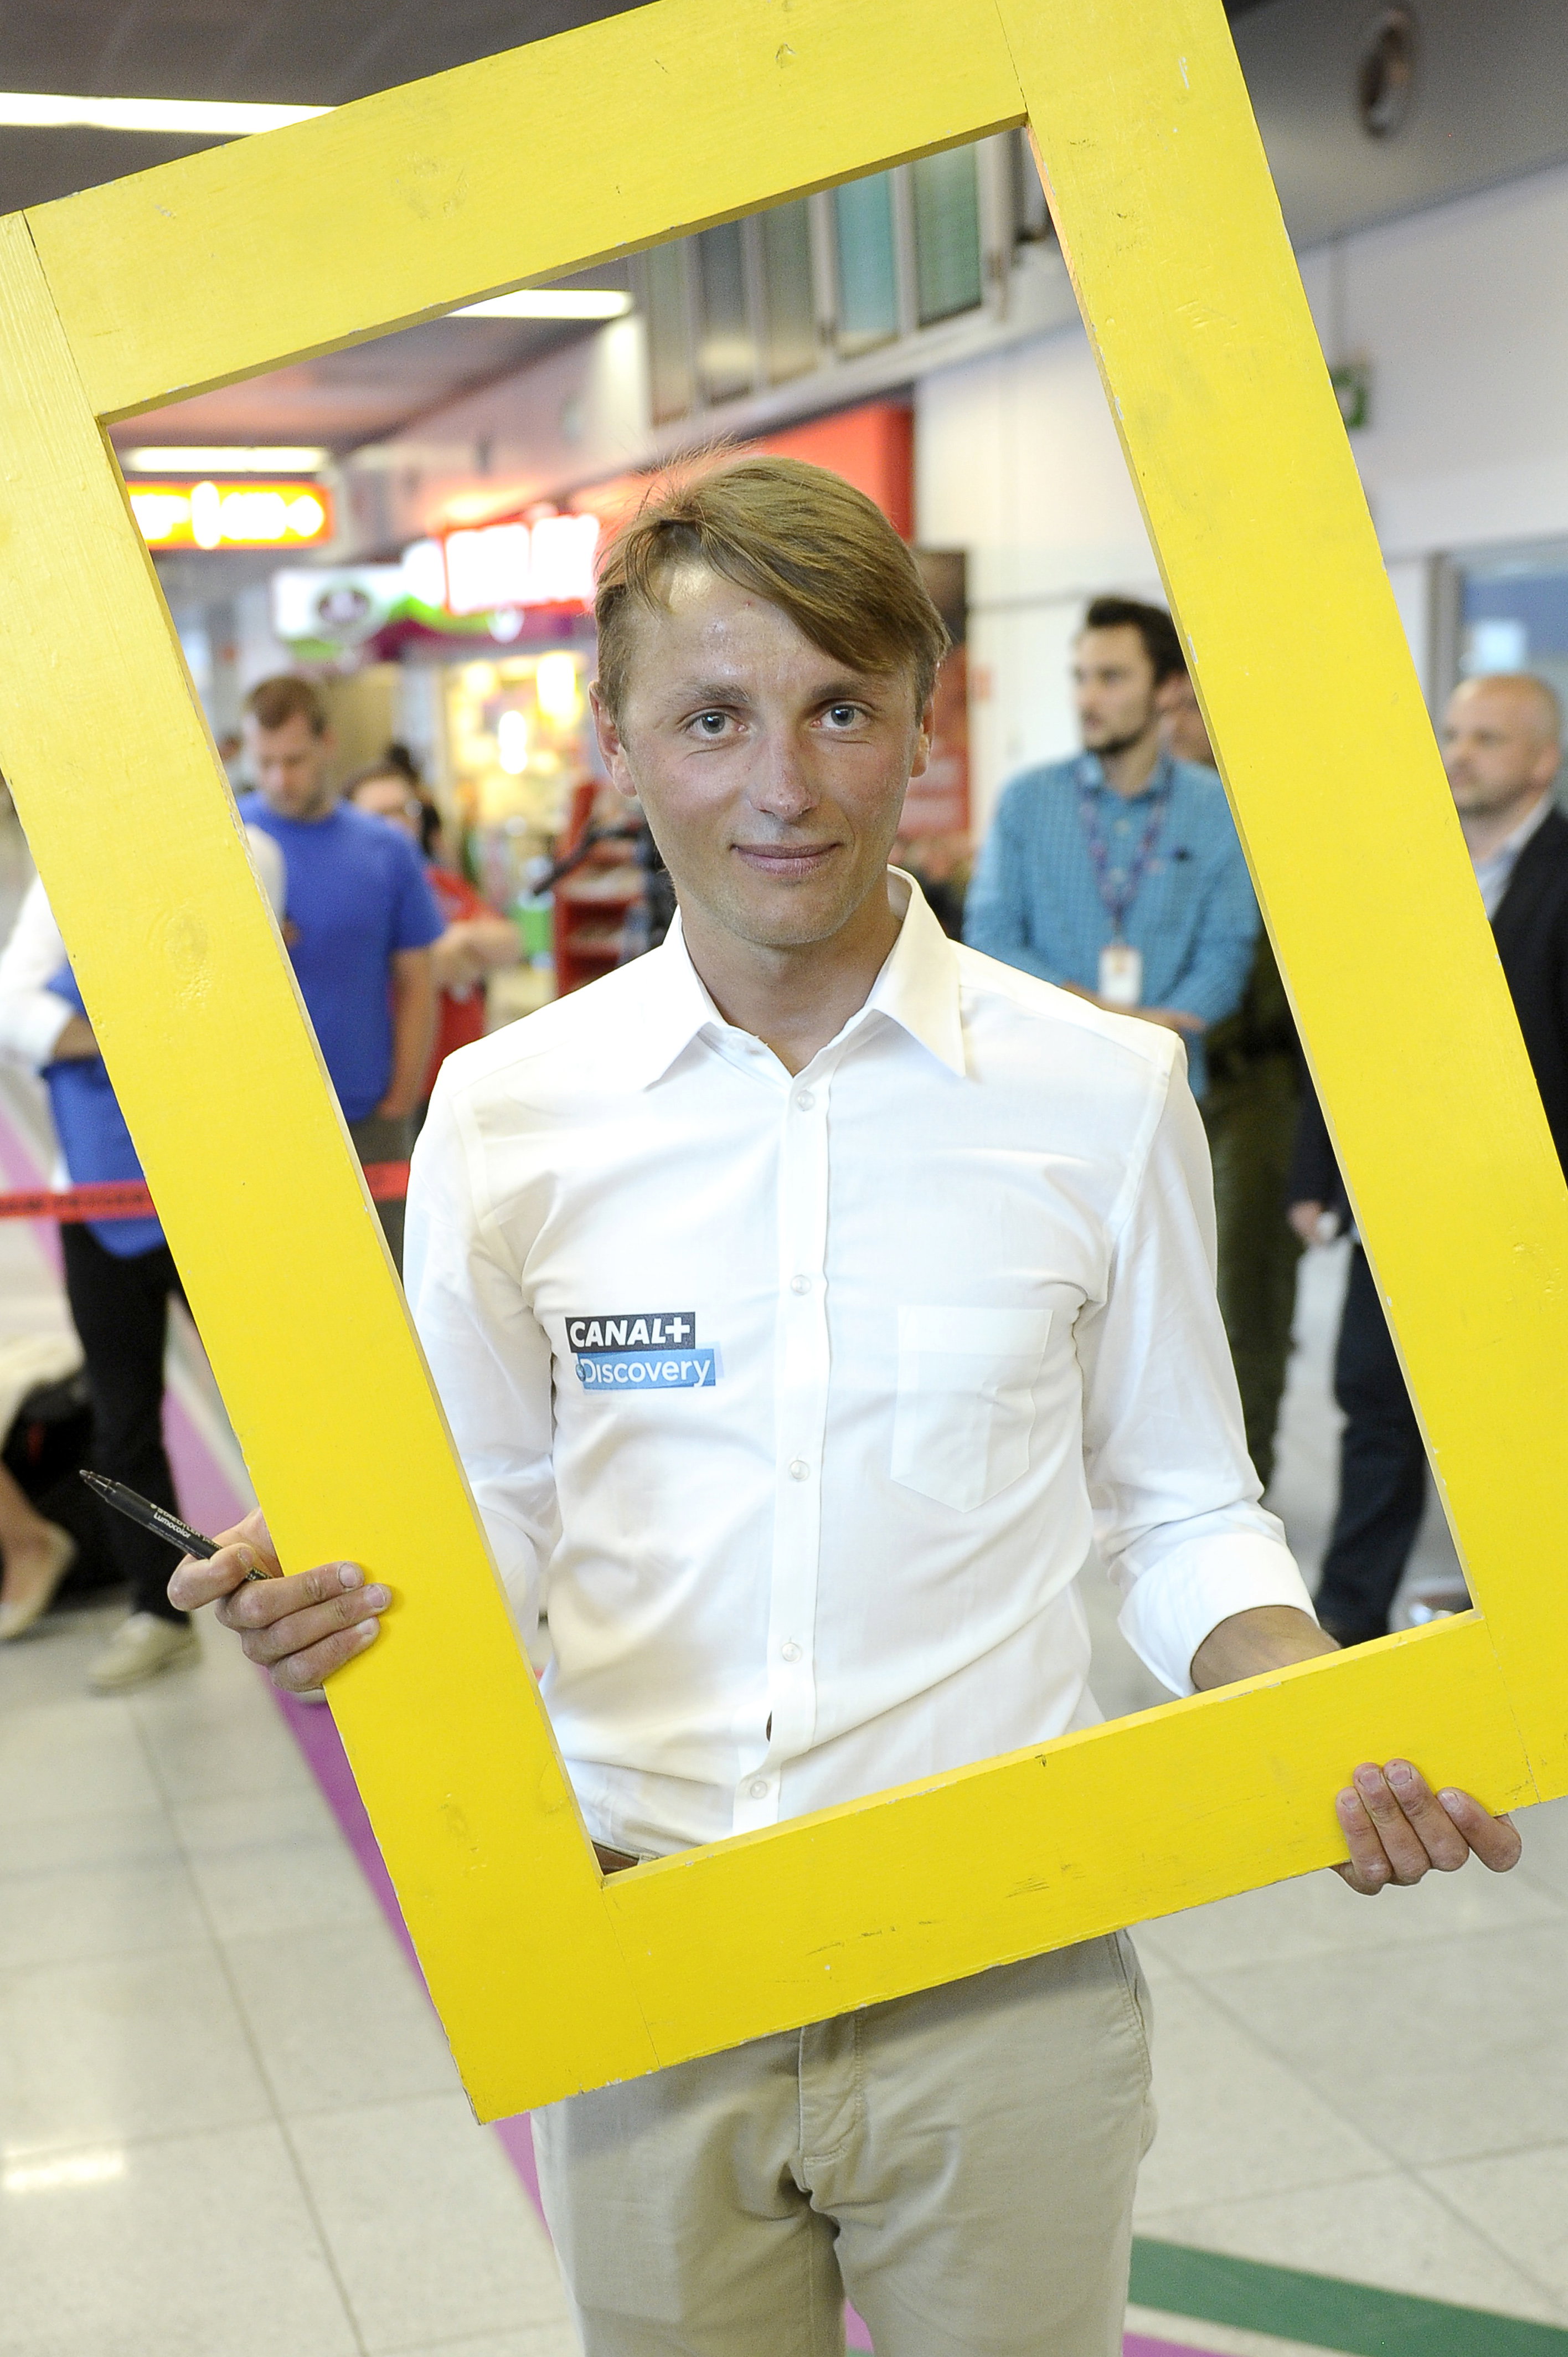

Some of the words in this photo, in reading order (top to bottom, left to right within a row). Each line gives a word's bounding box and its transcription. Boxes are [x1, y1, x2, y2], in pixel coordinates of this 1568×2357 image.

[570, 1317, 690, 1347] CANAL+
[579, 1358, 711, 1387] Discovery
[153, 1512, 192, 1538] Lumocolor
